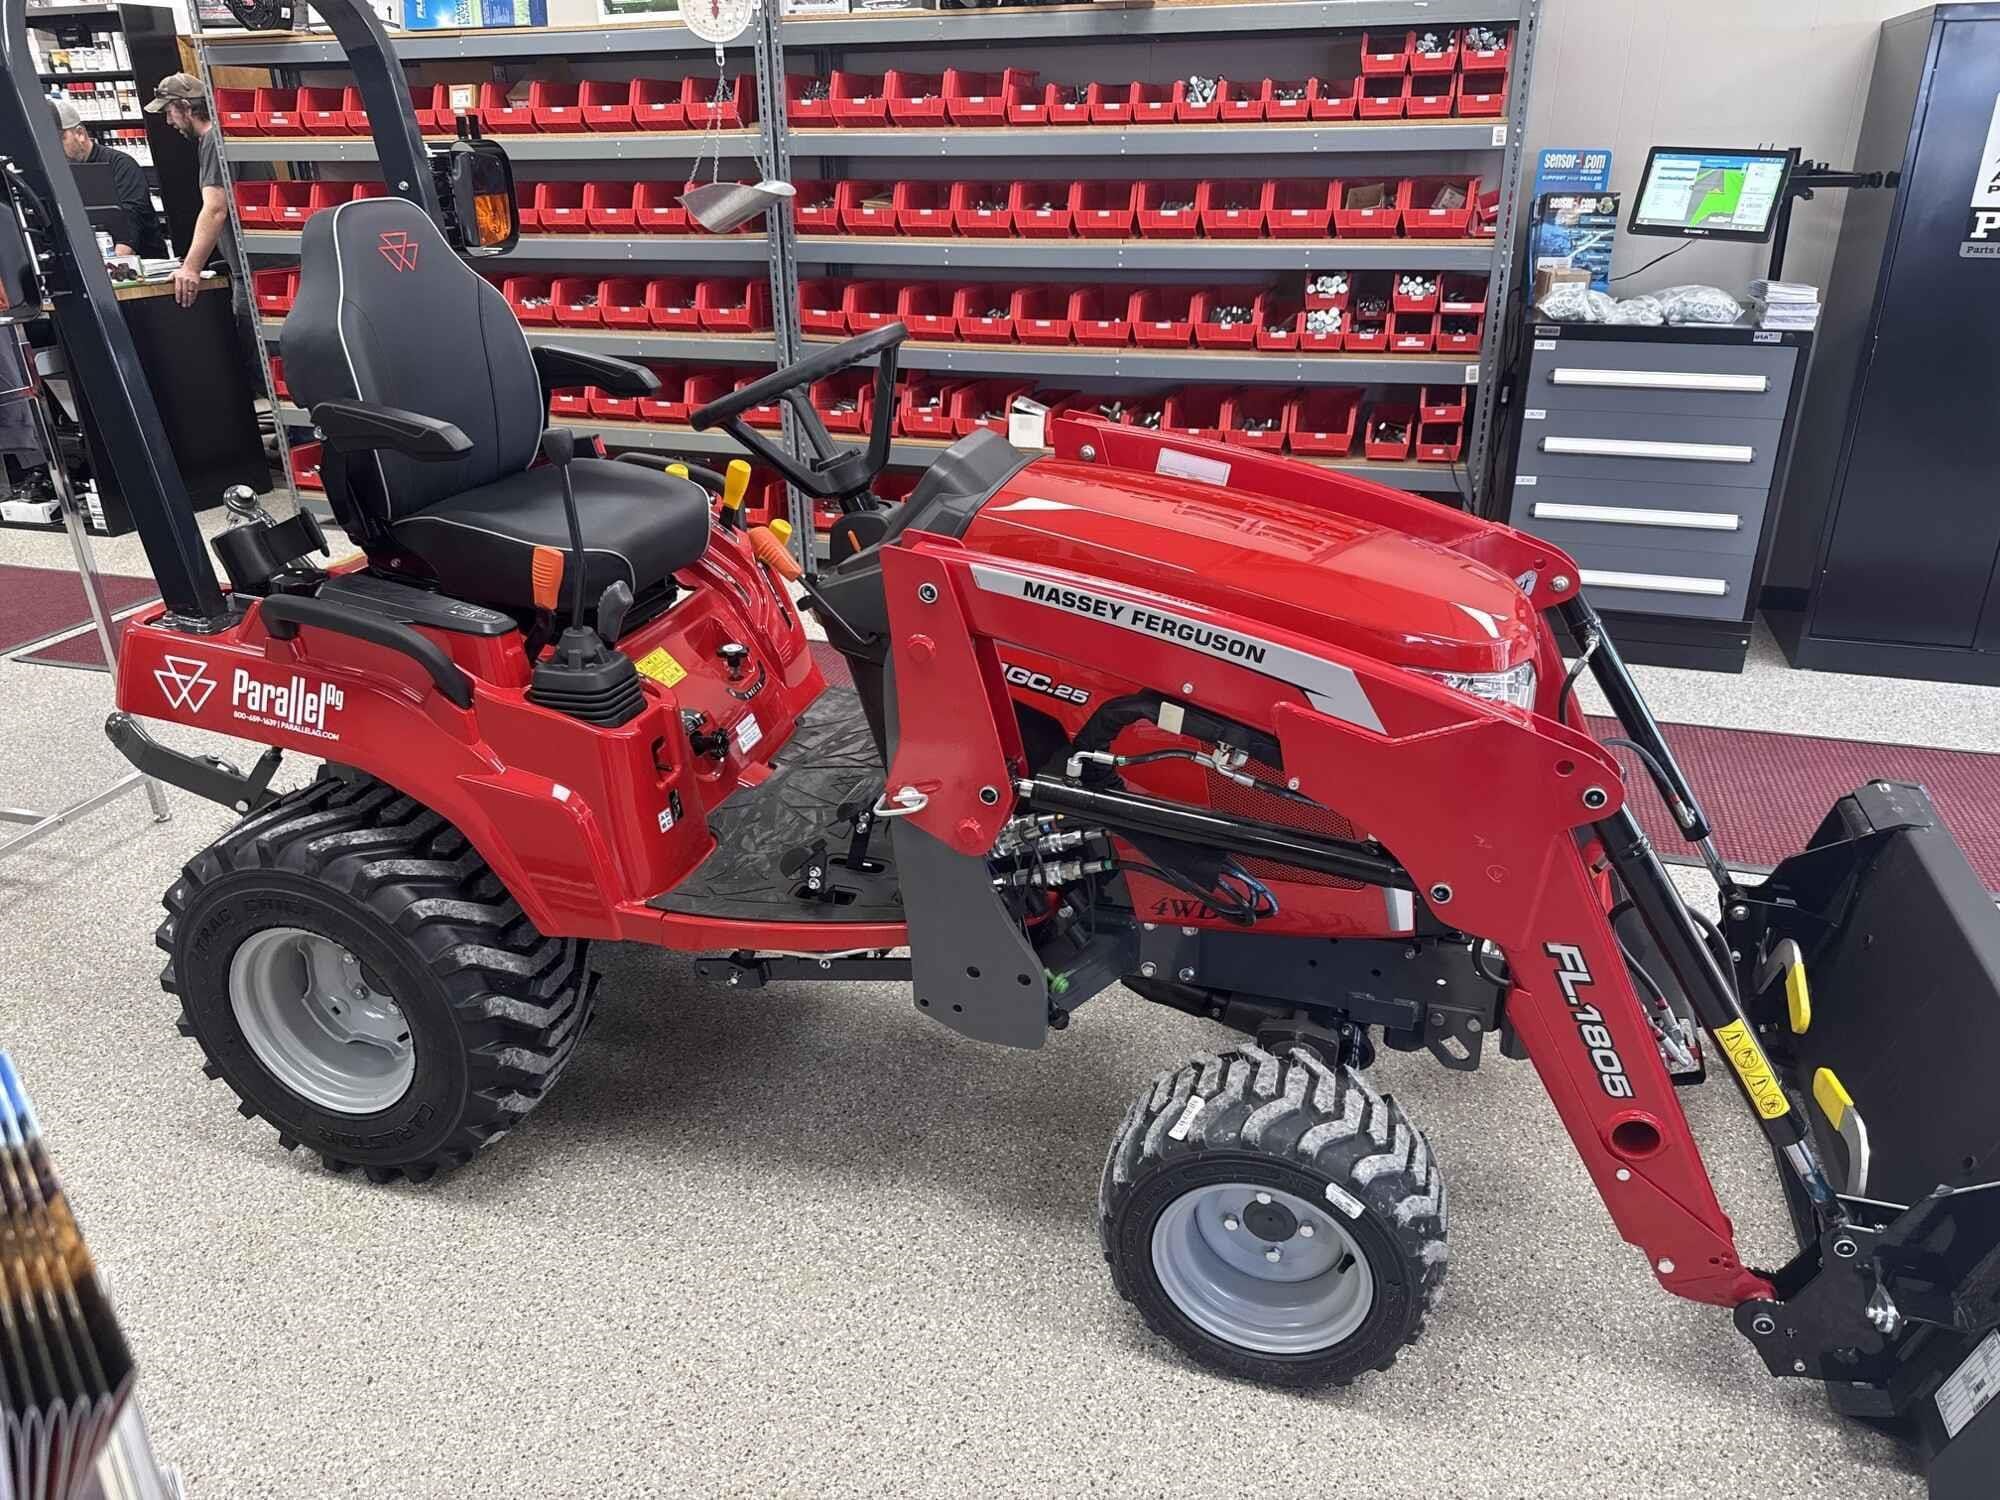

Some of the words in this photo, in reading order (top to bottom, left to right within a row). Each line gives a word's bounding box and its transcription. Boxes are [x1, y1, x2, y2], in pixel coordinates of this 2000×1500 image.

[1966, 245, 1995, 255] Parts
[1023, 580, 1125, 620] MASSEY
[1130, 610, 1266, 664] FERGUSON
[1001, 662, 1089, 704] GC.25
[280, 721, 340, 741] PARALLELAG.COM
[1545, 942, 1635, 1098] FL.1805
